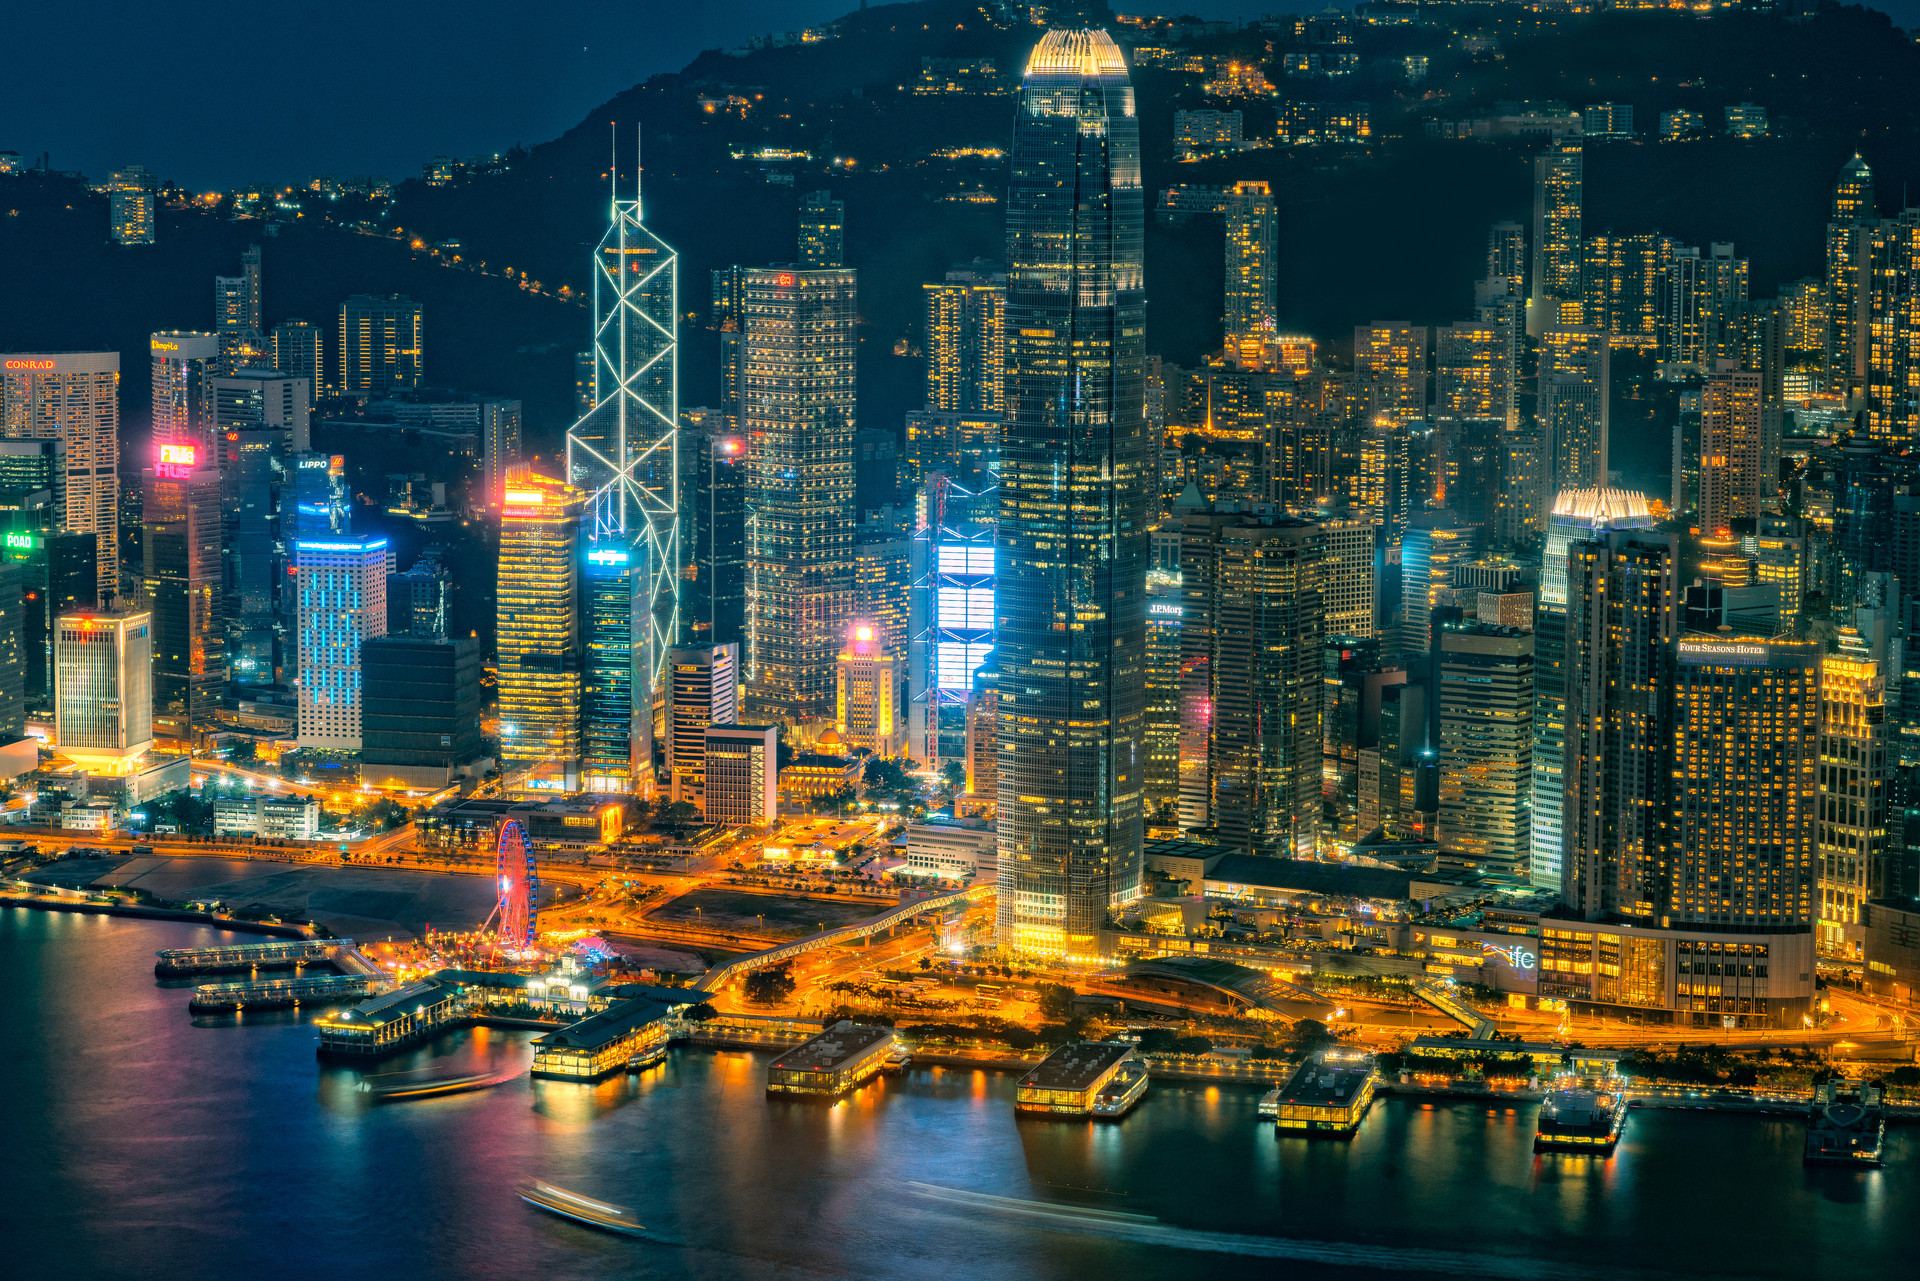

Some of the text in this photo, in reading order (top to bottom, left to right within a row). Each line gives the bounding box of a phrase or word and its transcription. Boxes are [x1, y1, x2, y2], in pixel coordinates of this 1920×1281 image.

[5, 360, 55, 369] CONRAD
[299, 460, 328, 469] LIPPO
[7, 534, 32, 548] POAD
[1680, 642, 1765, 654] FOUR SEASONS HOTEL
[1509, 945, 1535, 969] ifc
